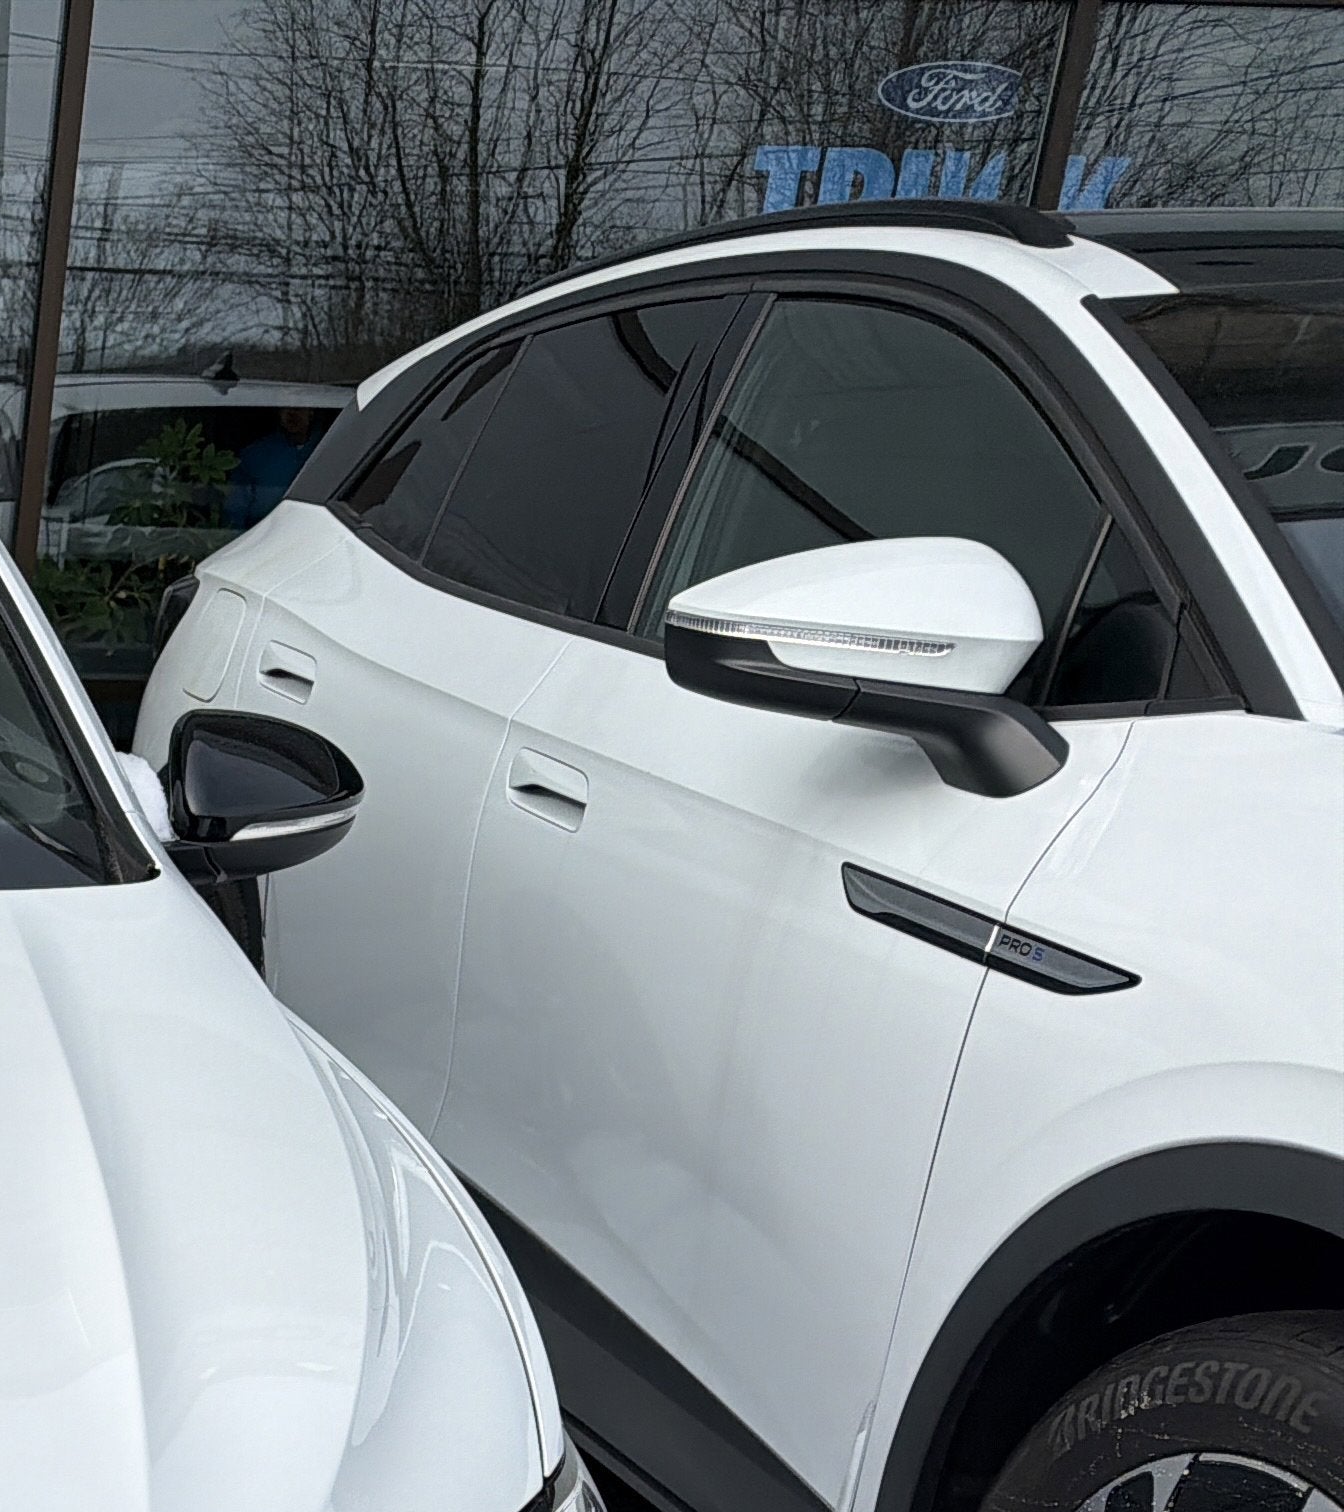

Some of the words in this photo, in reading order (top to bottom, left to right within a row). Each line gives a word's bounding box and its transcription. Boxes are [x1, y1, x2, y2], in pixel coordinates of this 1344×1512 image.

[906, 69, 1009, 113] Ford
[999, 934, 1032, 956] PRO
[1032, 947, 1045, 962] S
